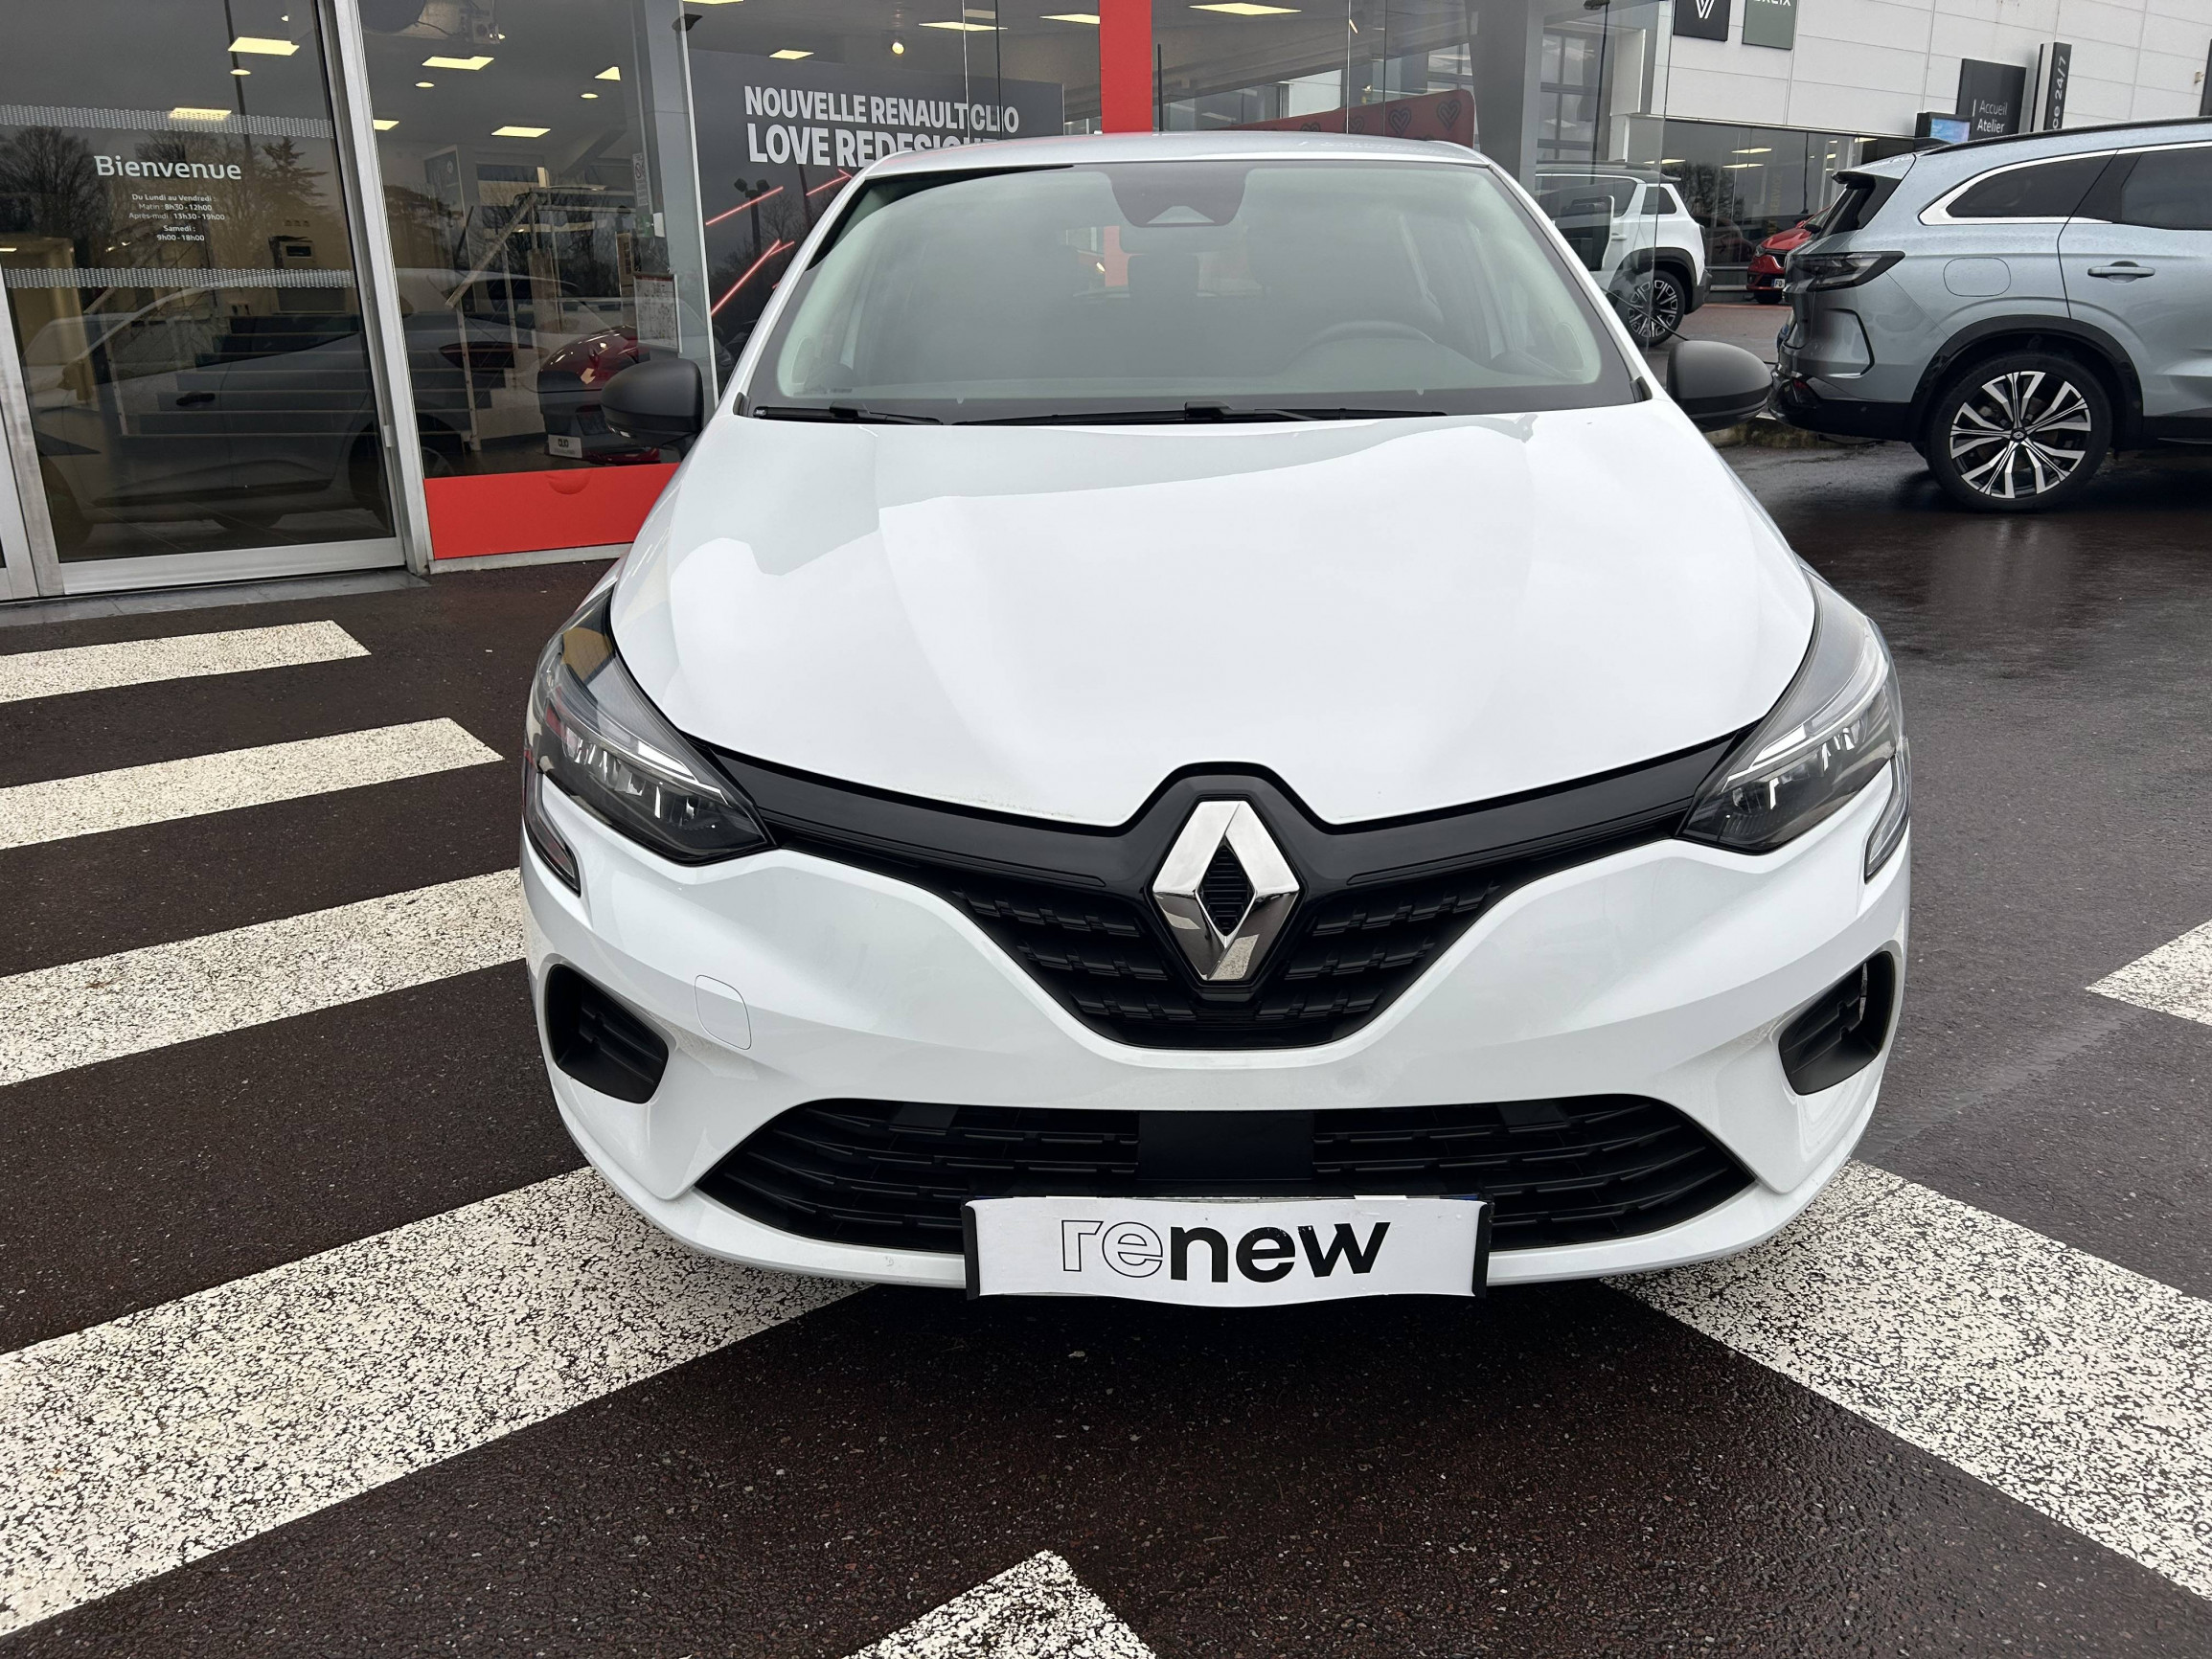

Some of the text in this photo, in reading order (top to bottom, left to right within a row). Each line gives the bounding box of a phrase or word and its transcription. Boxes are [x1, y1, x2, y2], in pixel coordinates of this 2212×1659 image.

[2054, 56, 2066, 101] 24/7
[744, 85, 1020, 134] NOUVELLE RENAULT CLIO
[1978, 100, 2008, 116] Accueil
[1976, 118, 2005, 133] Atelier
[746, 123, 831, 167] LOVE
[94, 155, 242, 180] Bienvenue
[128, 212, 169, 220] Après-midi
[1060, 1219, 1391, 1284] renew
